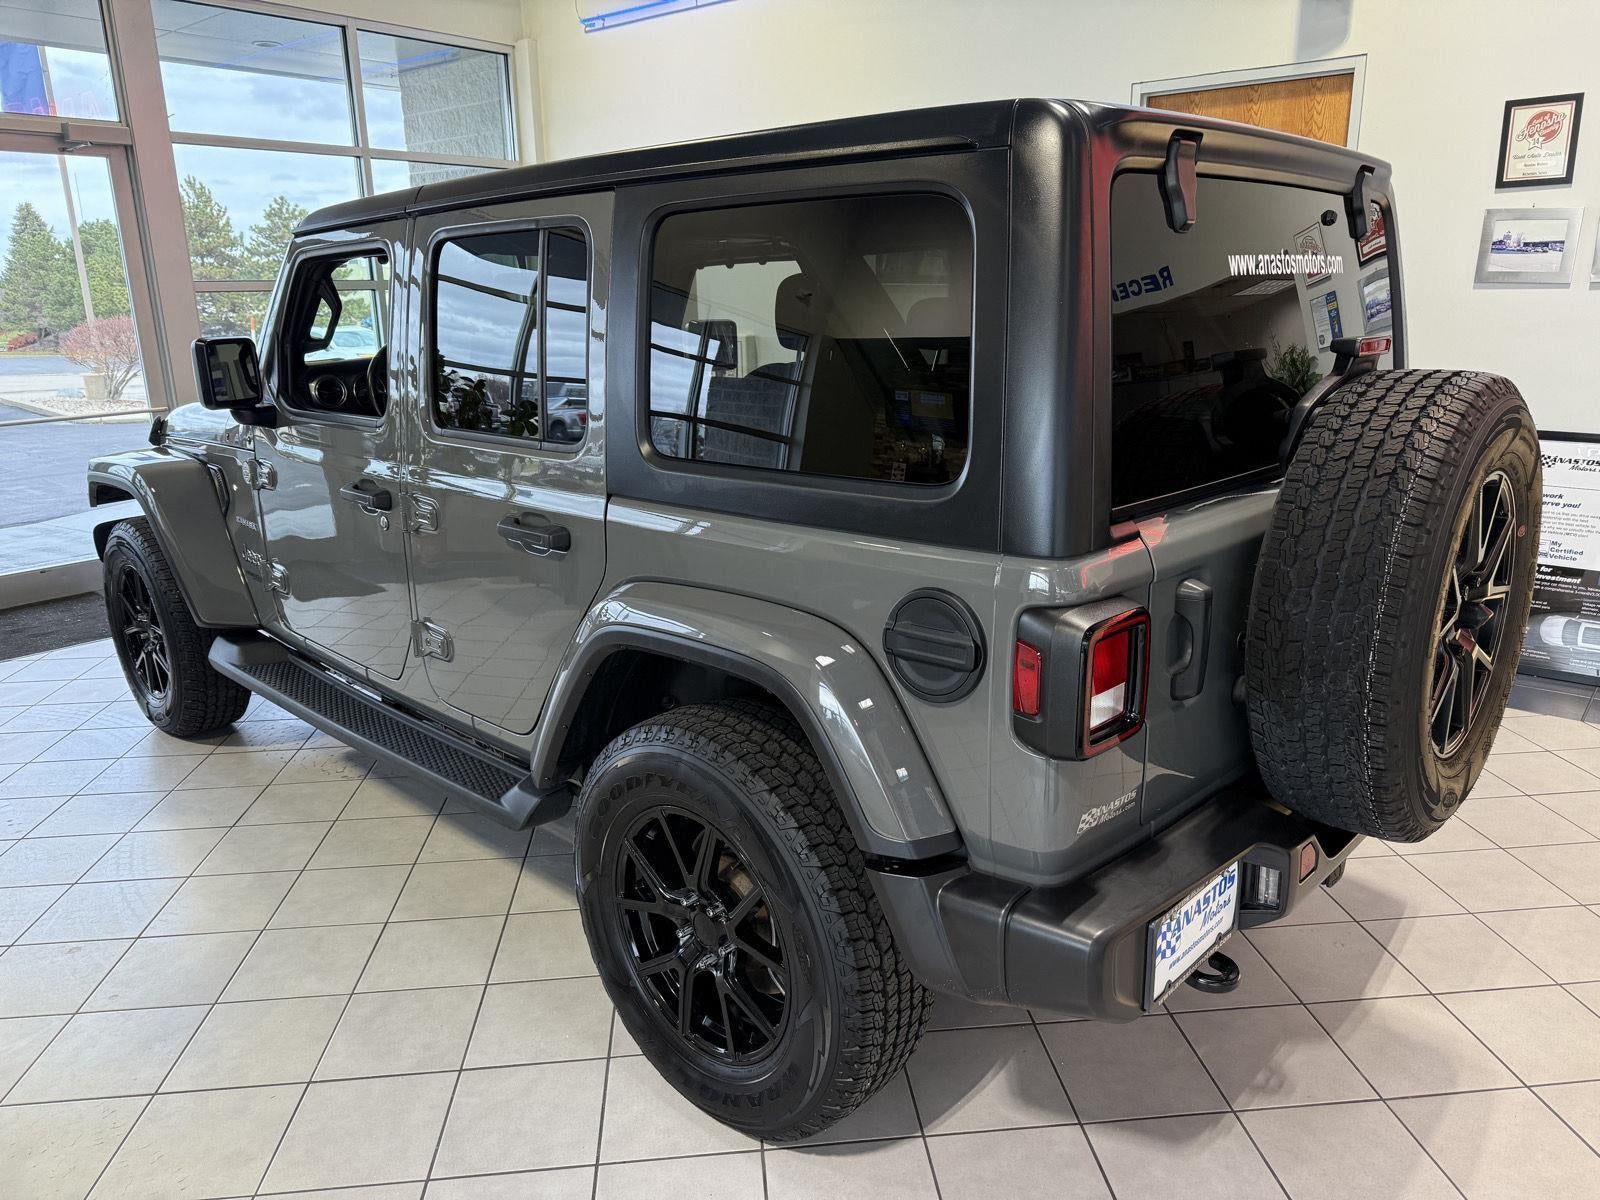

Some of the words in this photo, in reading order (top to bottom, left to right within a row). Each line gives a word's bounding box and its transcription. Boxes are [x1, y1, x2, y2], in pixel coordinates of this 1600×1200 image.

[1228, 248, 1344, 276] www.anastosmotors.com
[1550, 547, 1583, 555] Certified
[1172, 869, 1236, 938] ANASTOS
[1200, 894, 1231, 930] Motors
